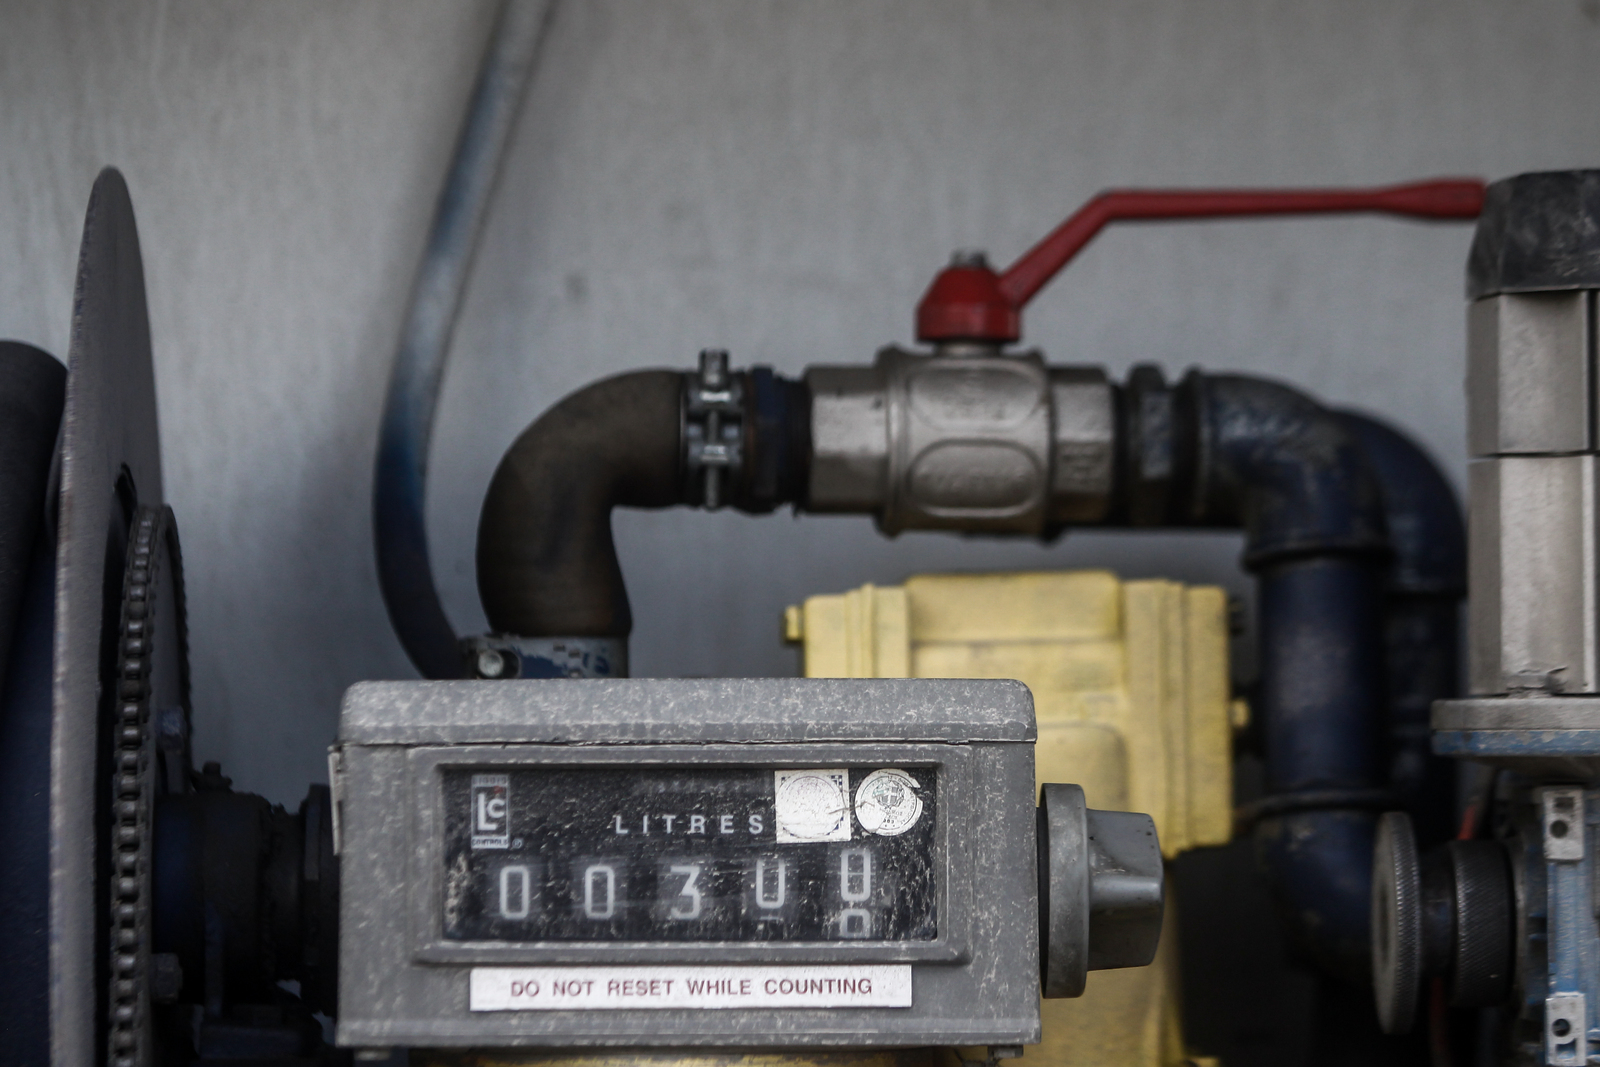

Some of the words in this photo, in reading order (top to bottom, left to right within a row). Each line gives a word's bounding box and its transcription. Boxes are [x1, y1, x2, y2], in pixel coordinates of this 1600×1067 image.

[614, 814, 764, 835] LITRES
[510, 980, 540, 997] DO
[552, 980, 595, 996] NOT
[607, 979, 675, 996] RESET
[686, 978, 752, 995] WHILE
[764, 978, 873, 995] COUNTING
